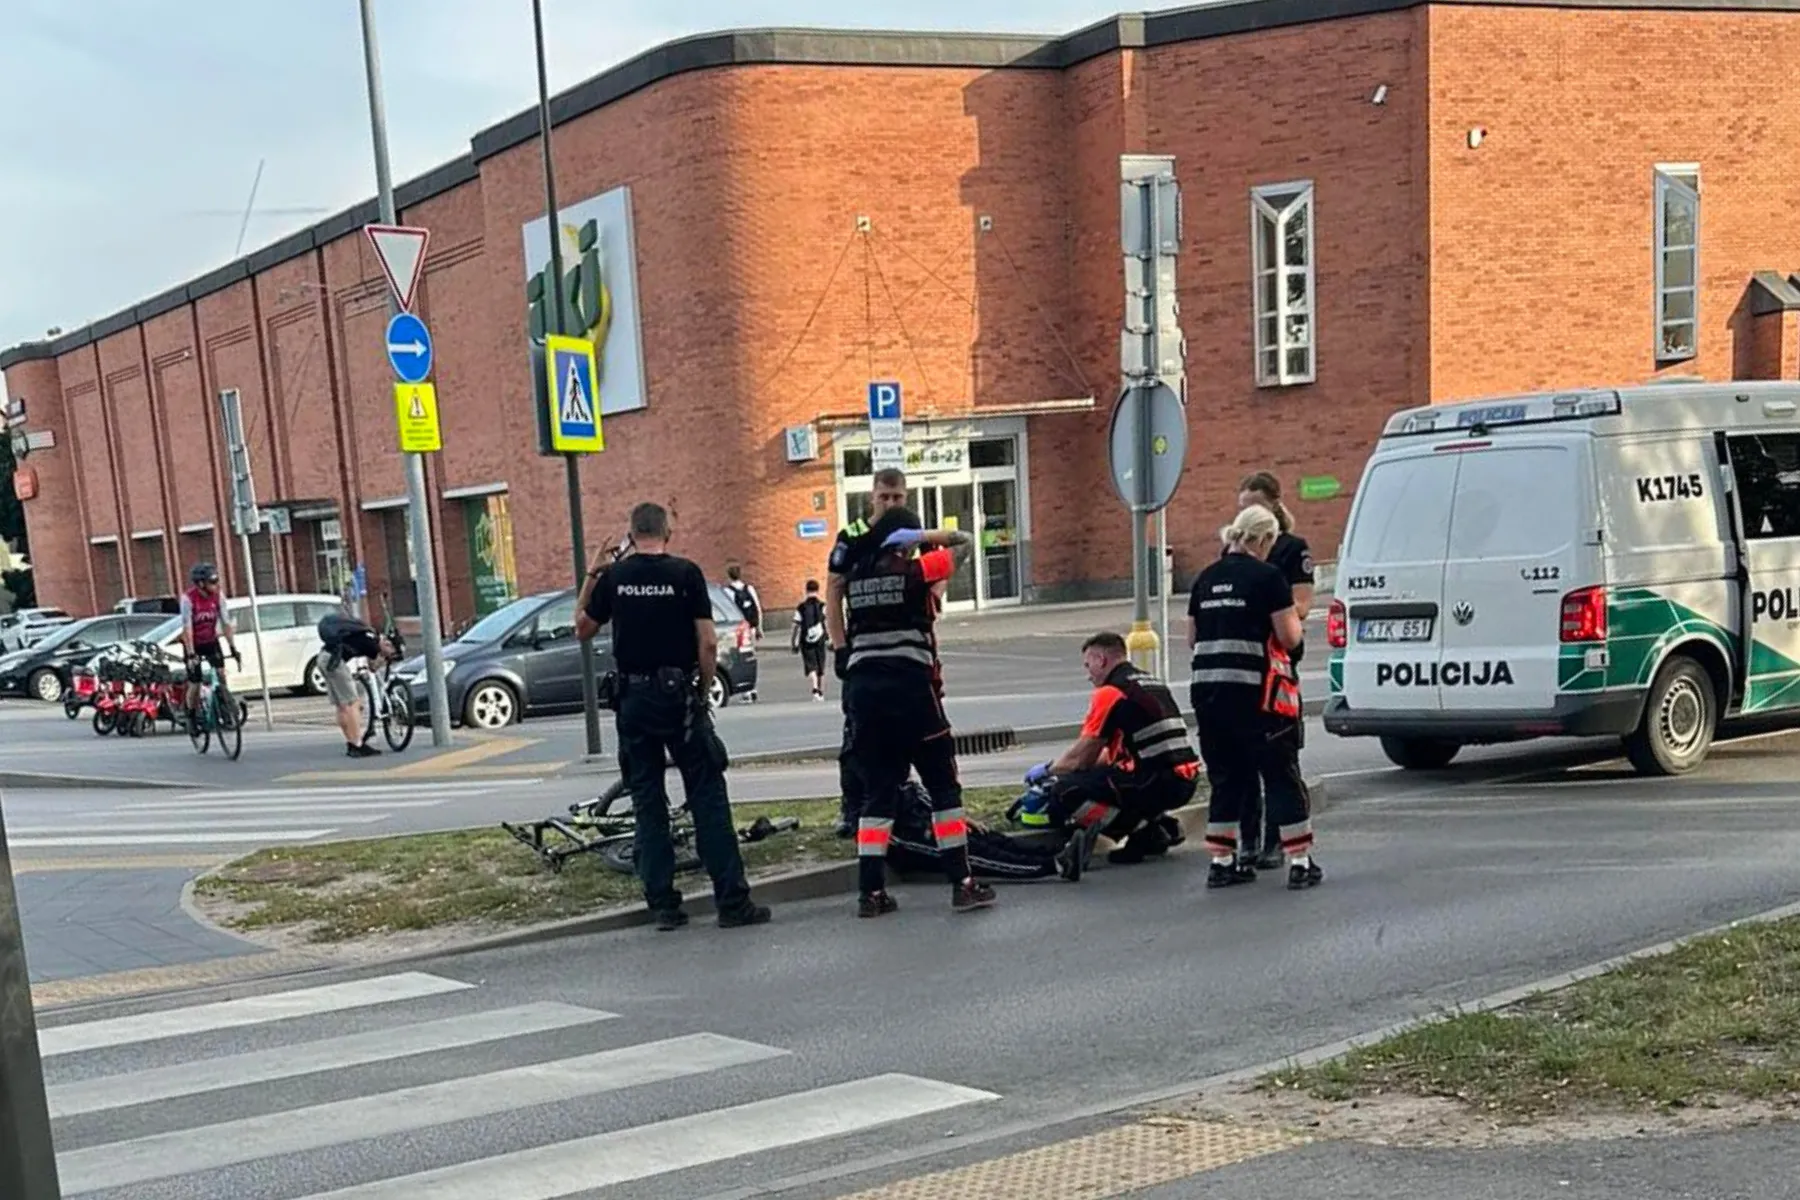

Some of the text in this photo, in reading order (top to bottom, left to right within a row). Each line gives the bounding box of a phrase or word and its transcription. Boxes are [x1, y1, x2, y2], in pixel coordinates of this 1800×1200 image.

[877, 385, 896, 416] P
[1636, 474, 1703, 503] K1745
[1348, 575, 1386, 590] K1745
[1532, 566, 1560, 580] 112
[617, 584, 675, 596] POLICIJA
[1752, 587, 1800, 623] POL
[1363, 619, 1395, 638] KTK
[1376, 660, 1514, 687] POLICIJA
